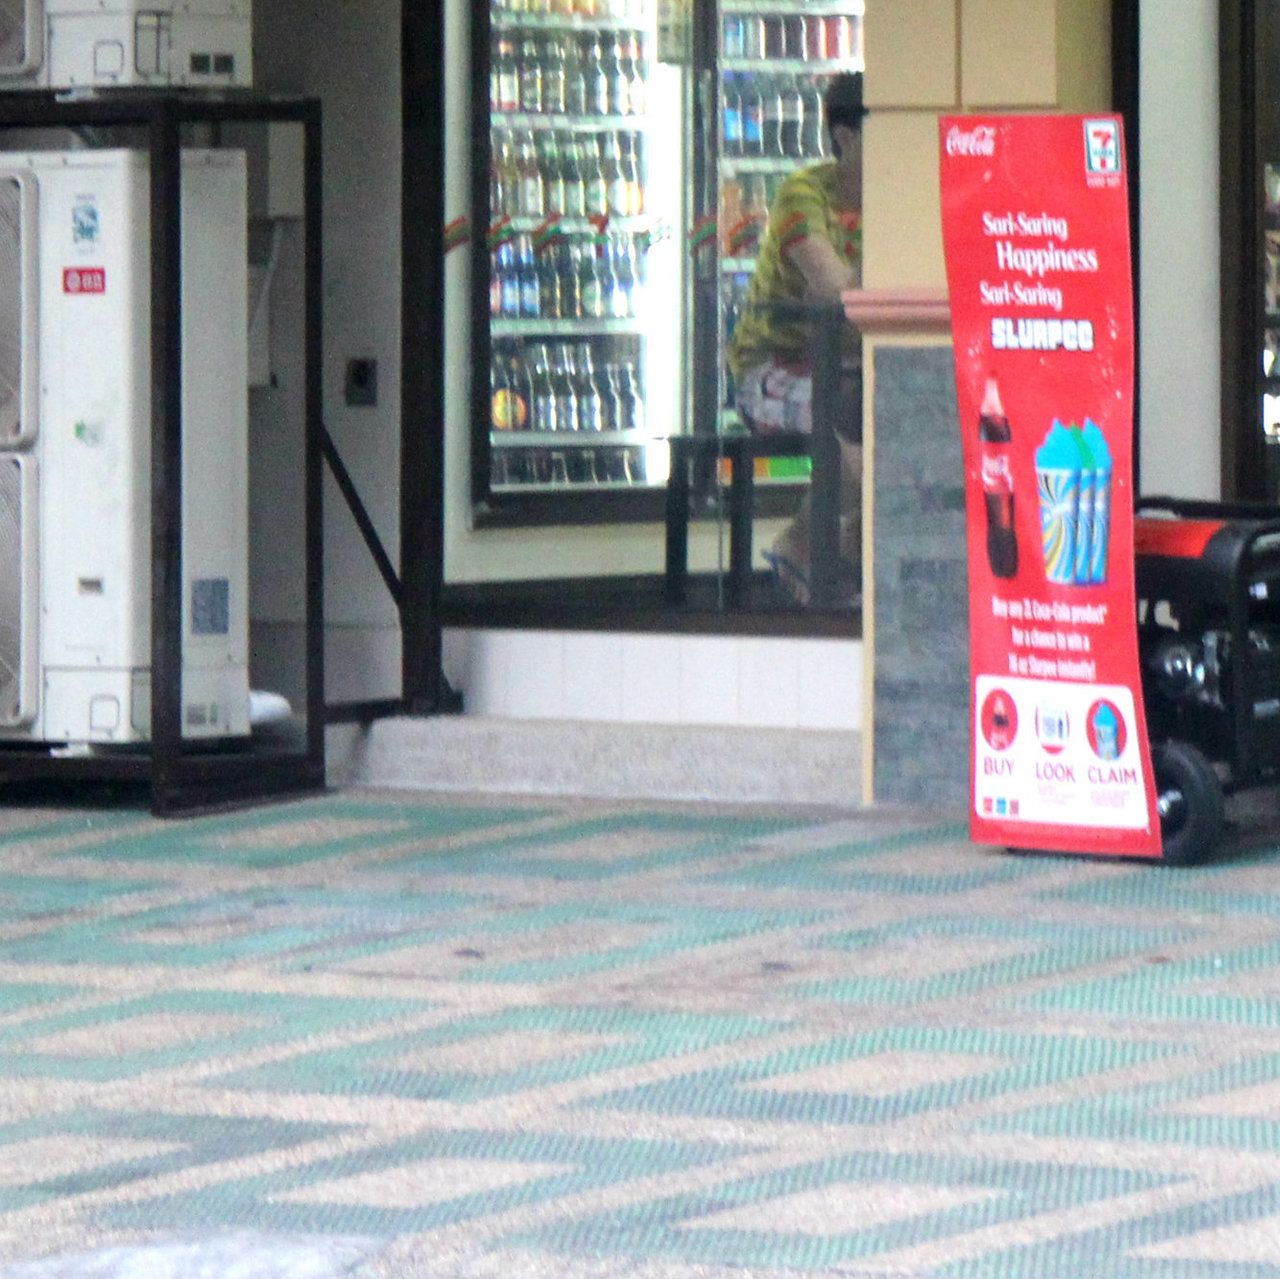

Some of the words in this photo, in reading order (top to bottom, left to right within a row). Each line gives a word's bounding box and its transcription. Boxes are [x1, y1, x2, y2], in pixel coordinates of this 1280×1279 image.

[982, 212, 1068, 241] Sari-Saring
[995, 241, 1098, 277] Happiness
[980, 281, 1062, 311] Sari-Saring
[984, 756, 1015, 776] BUY
[1036, 763, 1075, 783] LOOK
[1088, 767, 1138, 785] CLAIM
